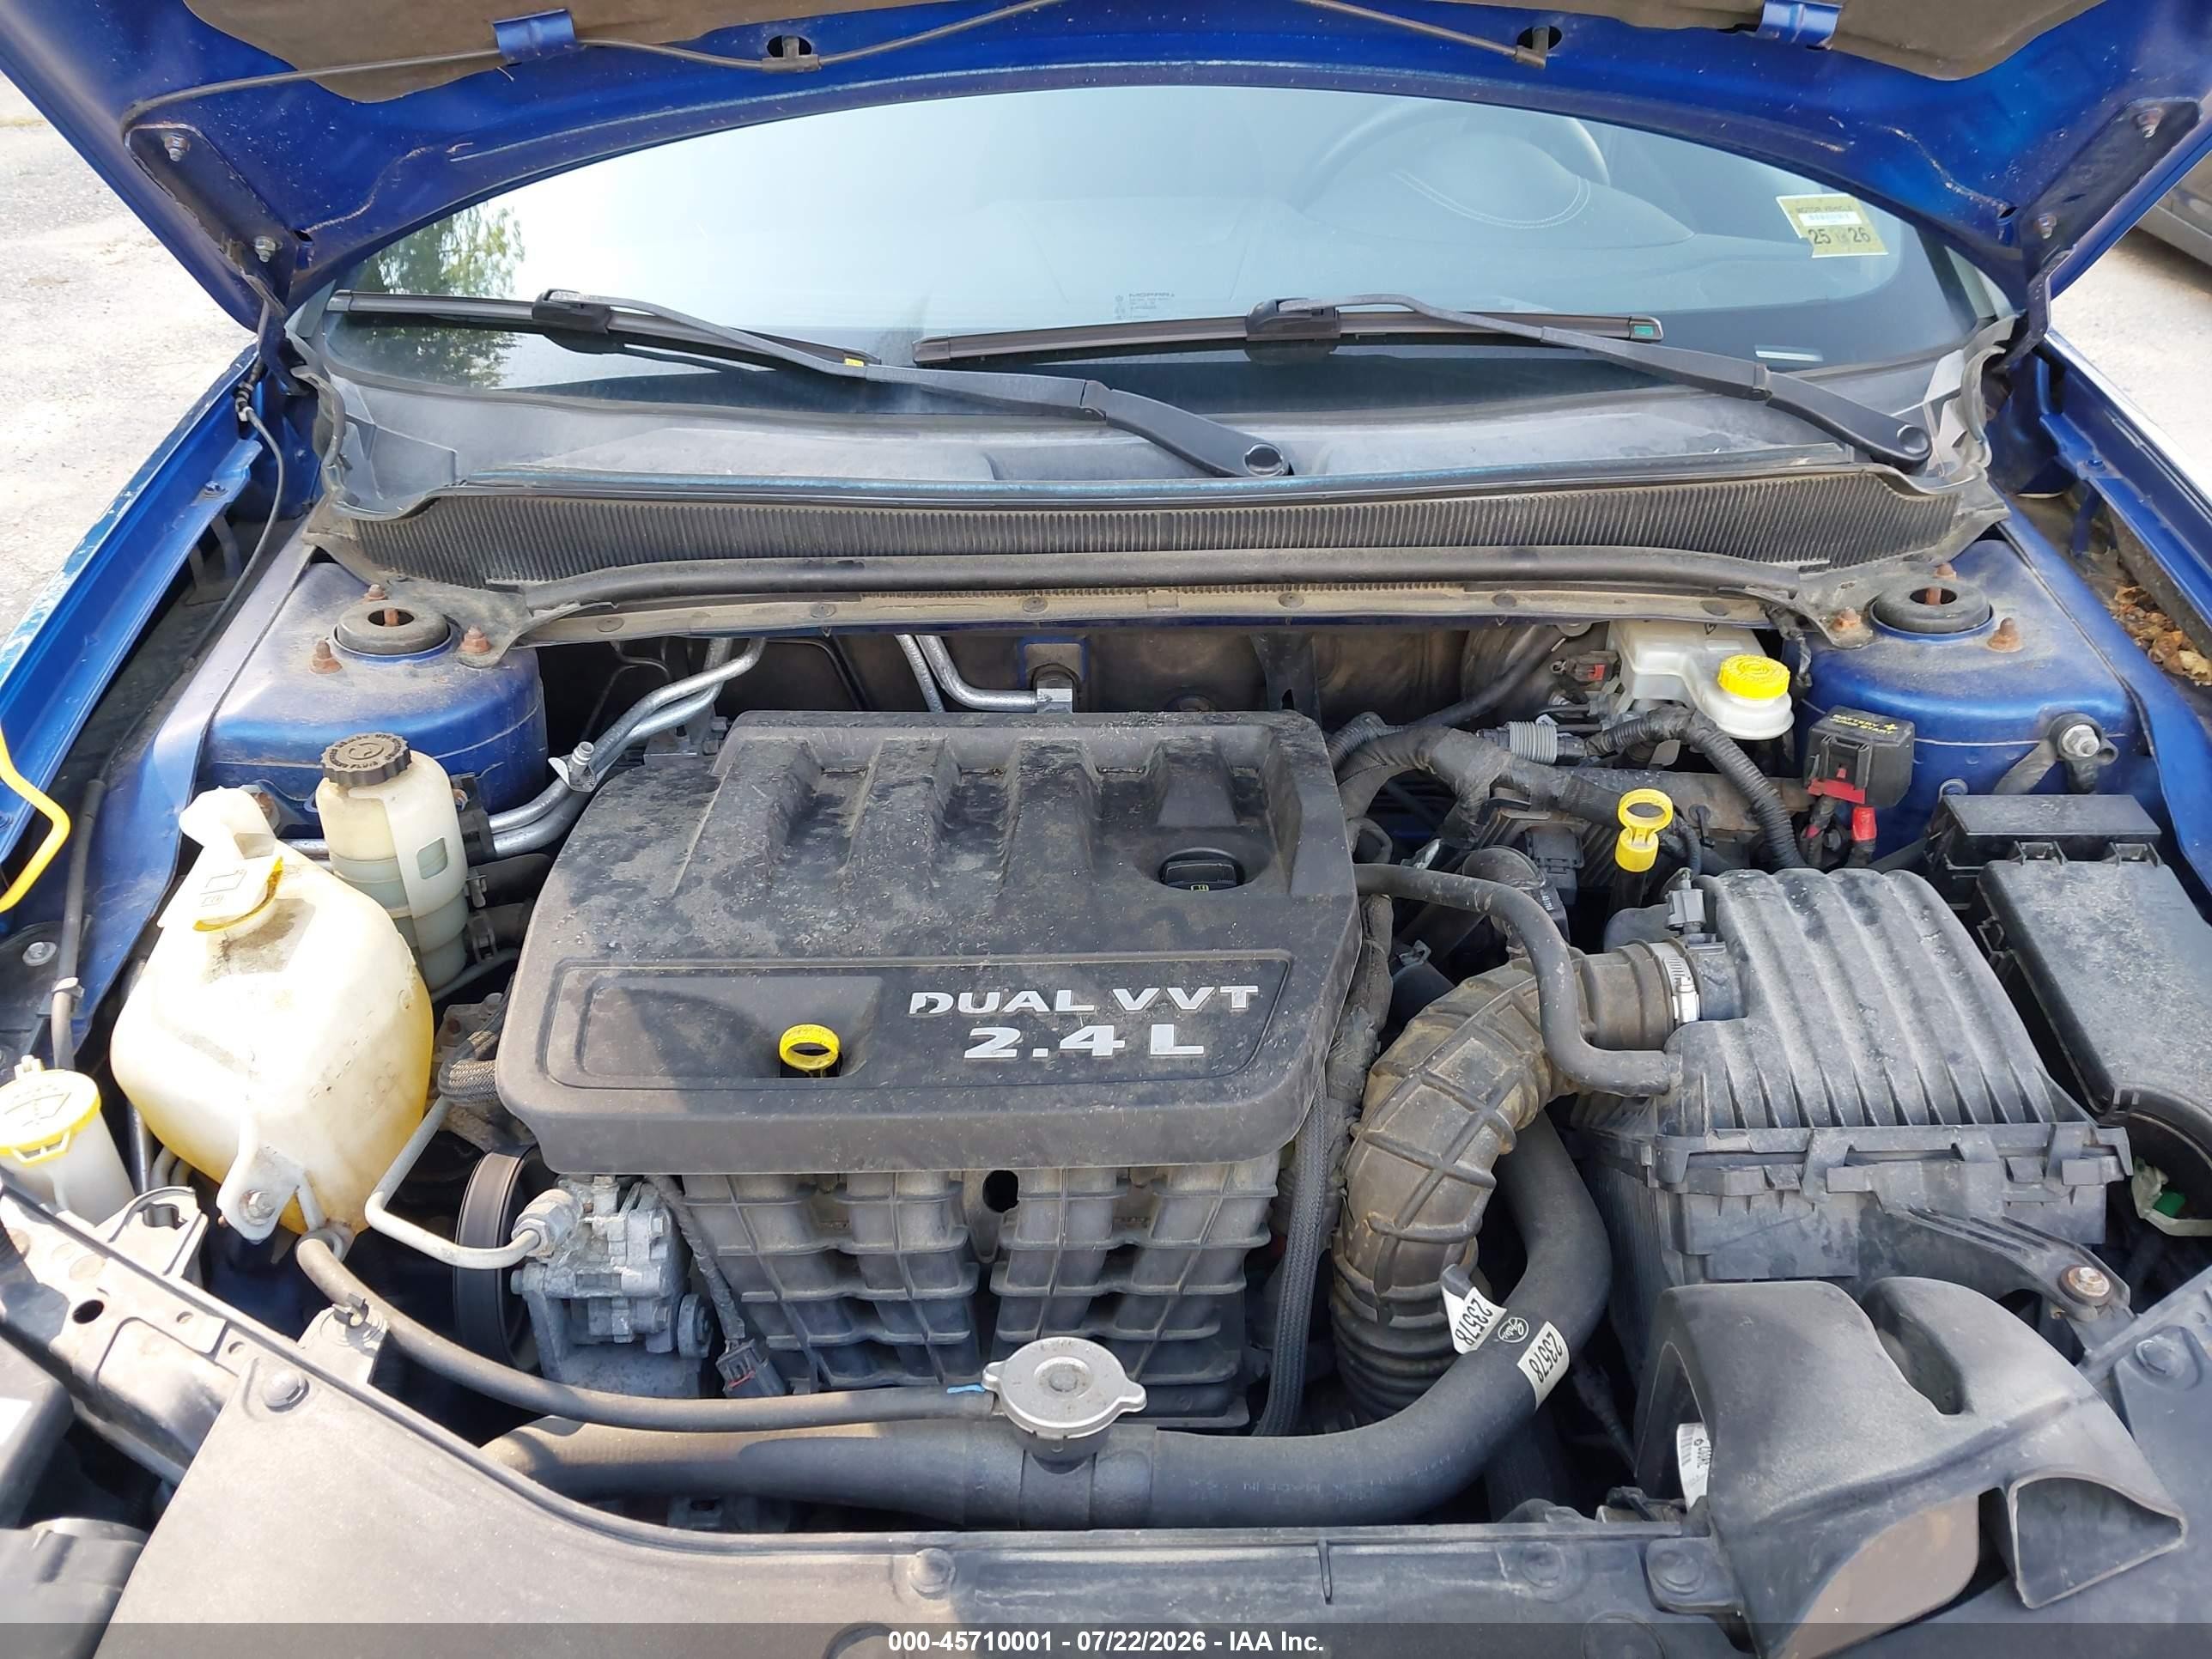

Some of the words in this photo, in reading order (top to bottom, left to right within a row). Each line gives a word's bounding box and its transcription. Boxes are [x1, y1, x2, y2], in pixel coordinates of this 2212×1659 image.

[1808, 228, 1832, 245] 25
[1847, 227, 1870, 243] 26
[1832, 714, 1879, 728] BATTERY
[908, 989, 1096, 1015] DUAL
[1113, 985, 1260, 1012] VVT
[963, 1024, 1126, 1058] 2.4
[1150, 1023, 1205, 1056] L
[1454, 1297, 1494, 1346] 23578
[1528, 1332, 1563, 1383] 23578
